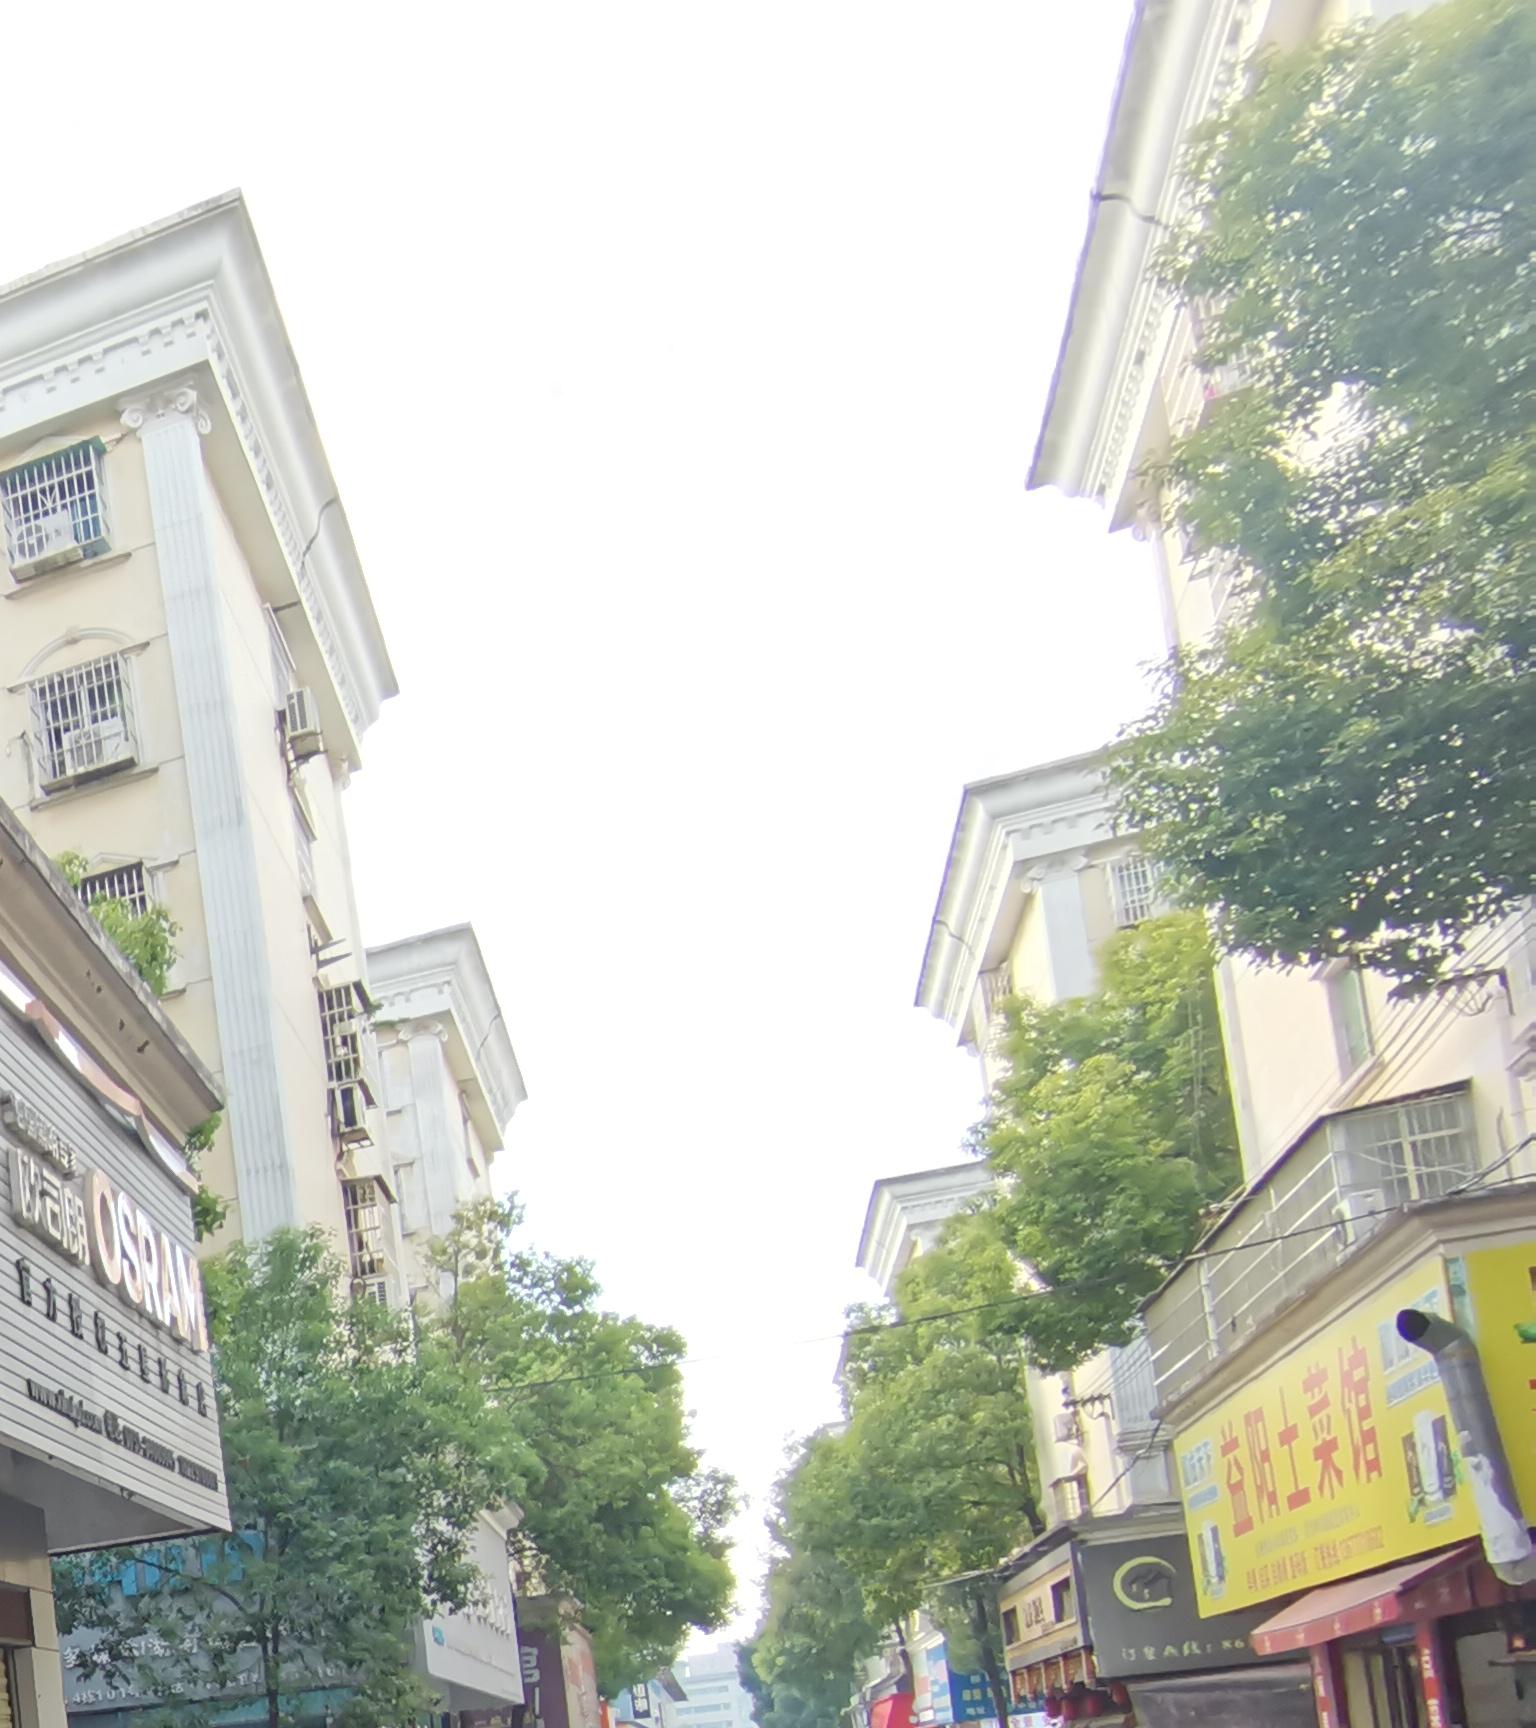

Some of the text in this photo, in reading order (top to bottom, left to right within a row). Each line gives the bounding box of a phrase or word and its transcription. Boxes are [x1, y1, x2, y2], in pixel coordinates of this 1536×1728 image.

[10, 1147, 209, 1354] 欧司朗 OSRAM
[1220, 1335, 1383, 1538] 益阳土菜馆
